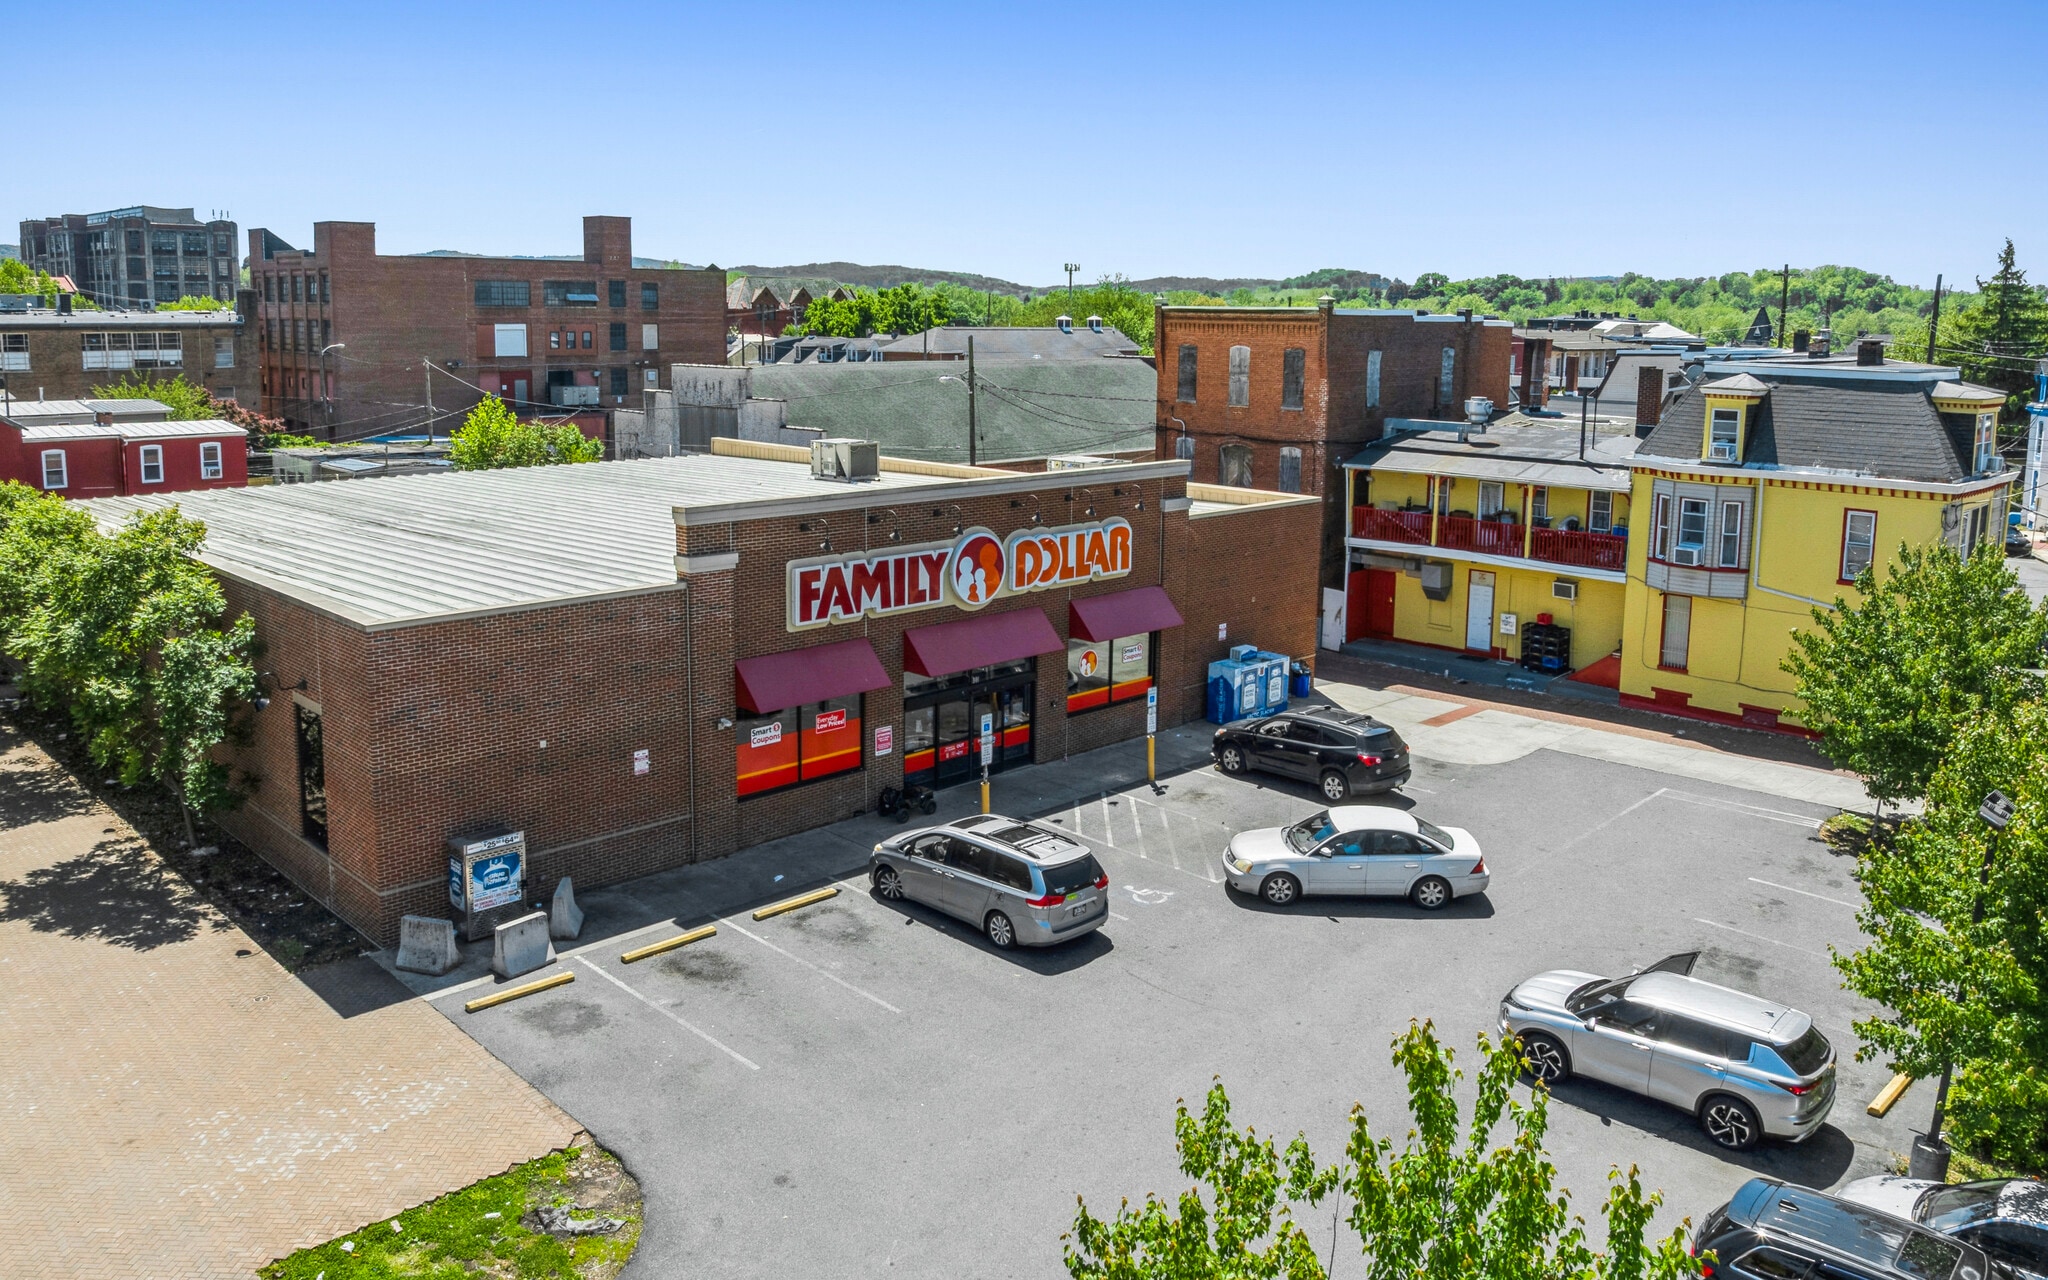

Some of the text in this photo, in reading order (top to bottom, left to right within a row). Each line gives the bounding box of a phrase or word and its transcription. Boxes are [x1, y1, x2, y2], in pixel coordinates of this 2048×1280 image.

[799, 525, 1131, 623] FAMILY DOLLAR
[1123, 646, 1137, 654] Smart
[1123, 652, 1142, 661] Coupons
[817, 714, 839, 724] Everyday
[817, 721, 828, 729] Low
[751, 726, 772, 737] Smart
[751, 733, 781, 745] Coupons
